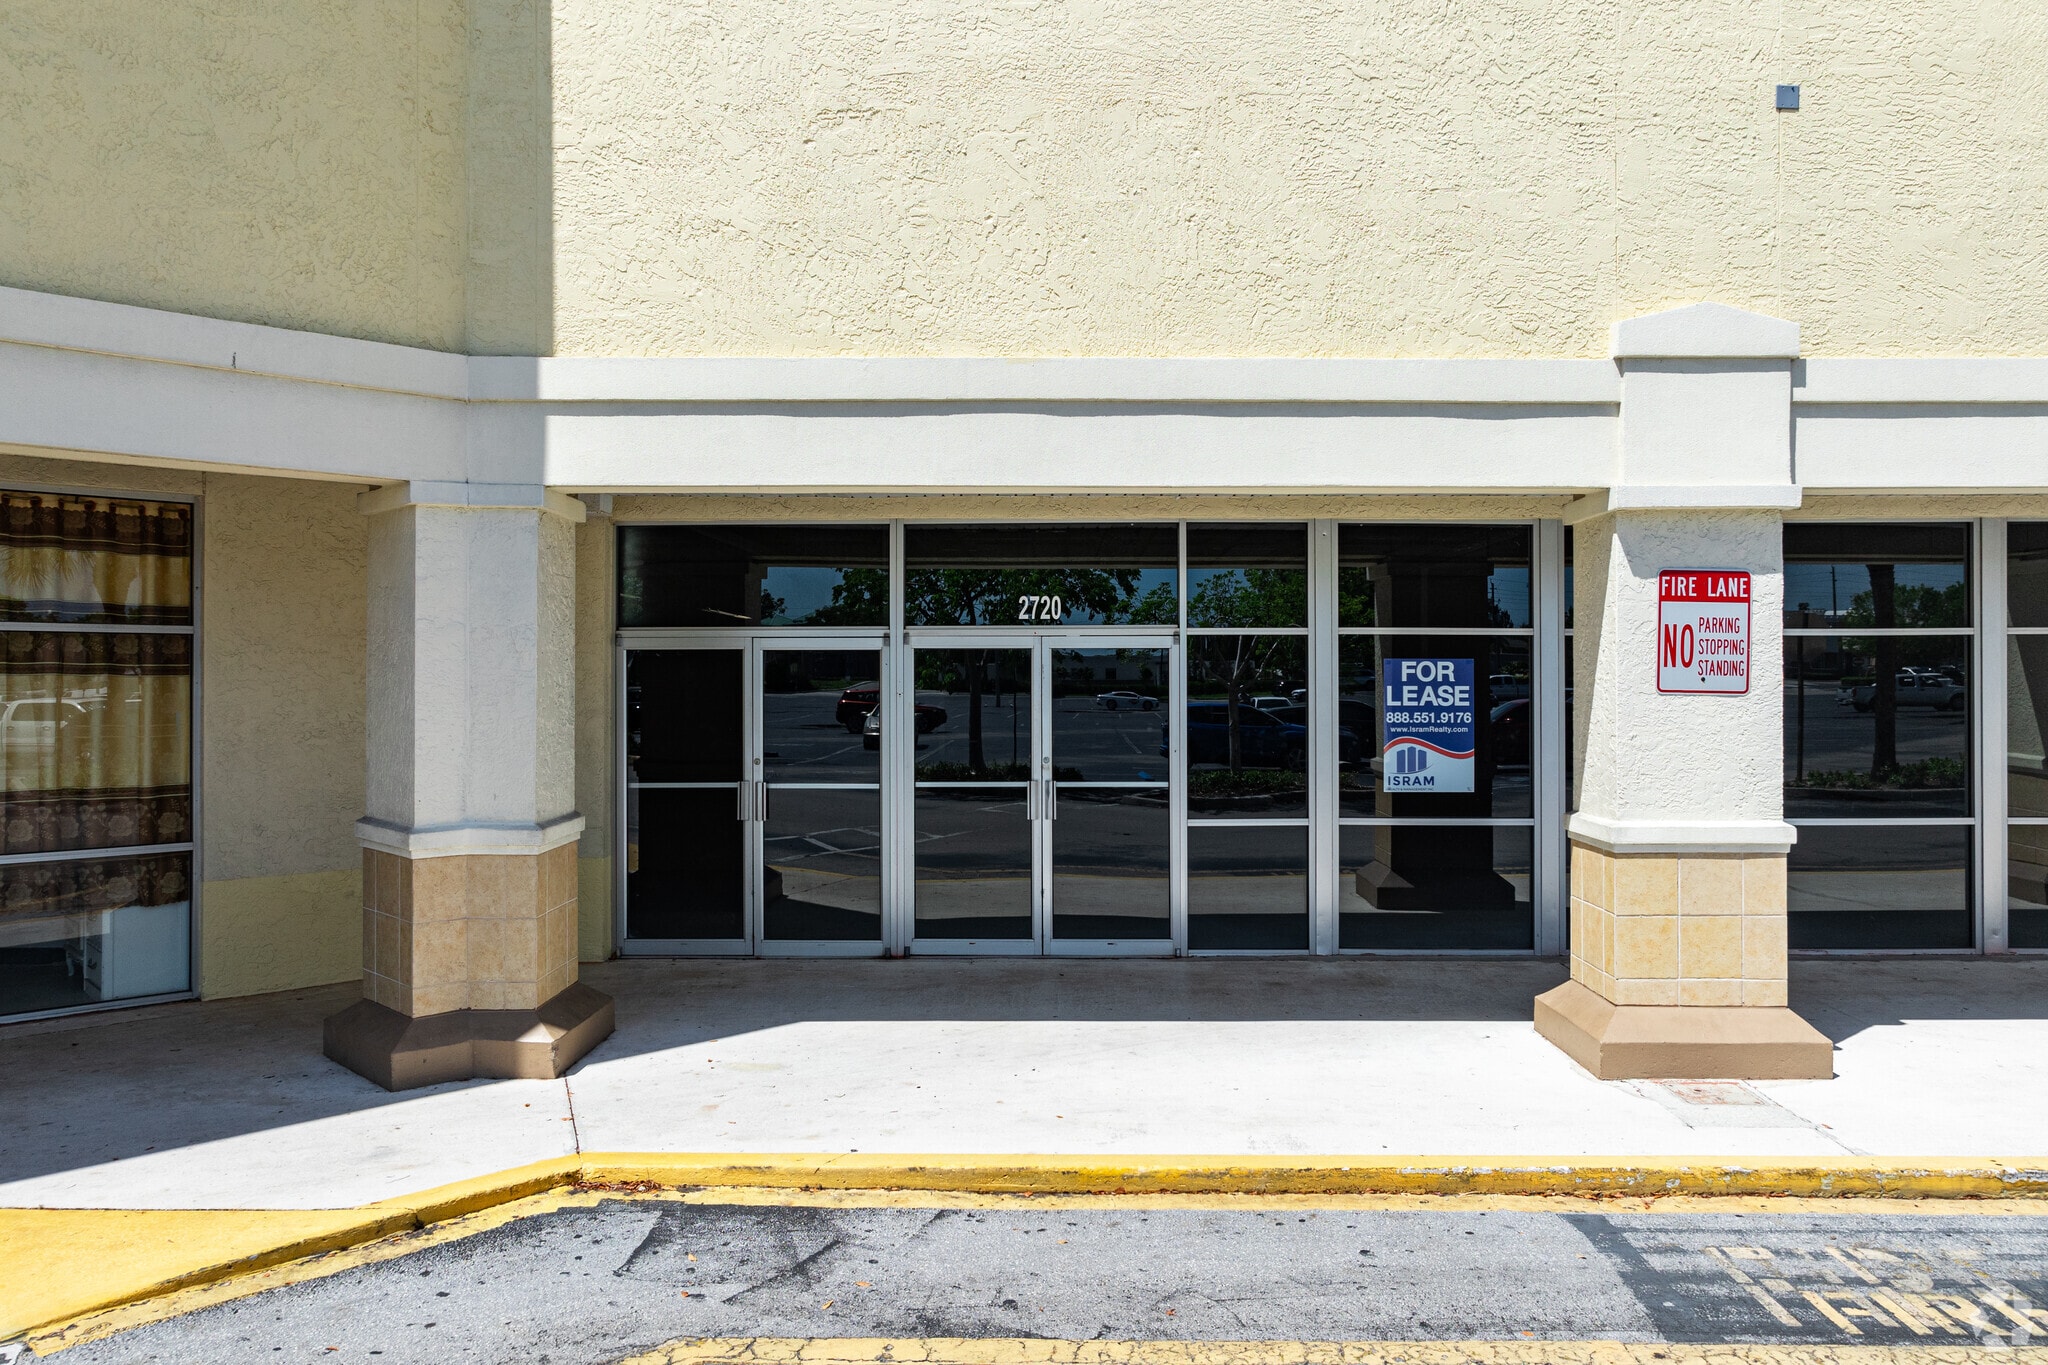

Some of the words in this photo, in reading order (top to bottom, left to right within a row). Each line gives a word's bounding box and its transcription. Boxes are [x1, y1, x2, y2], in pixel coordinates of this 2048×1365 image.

[1661, 576, 1697, 596] FIRE
[1707, 577, 1748, 597] LANE
[1018, 595, 1062, 620] 2720
[1698, 617, 1740, 633] PARKING
[1663, 623, 1694, 668] NO
[1698, 638, 1744, 655] STOPPING
[1401, 661, 1455, 682] FOR
[1697, 659, 1744, 676] STANDING
[1386, 685, 1470, 706] LEASE
[1386, 712, 1472, 724] 888.551.9176
[1388, 775, 1435, 786] ISRAM
